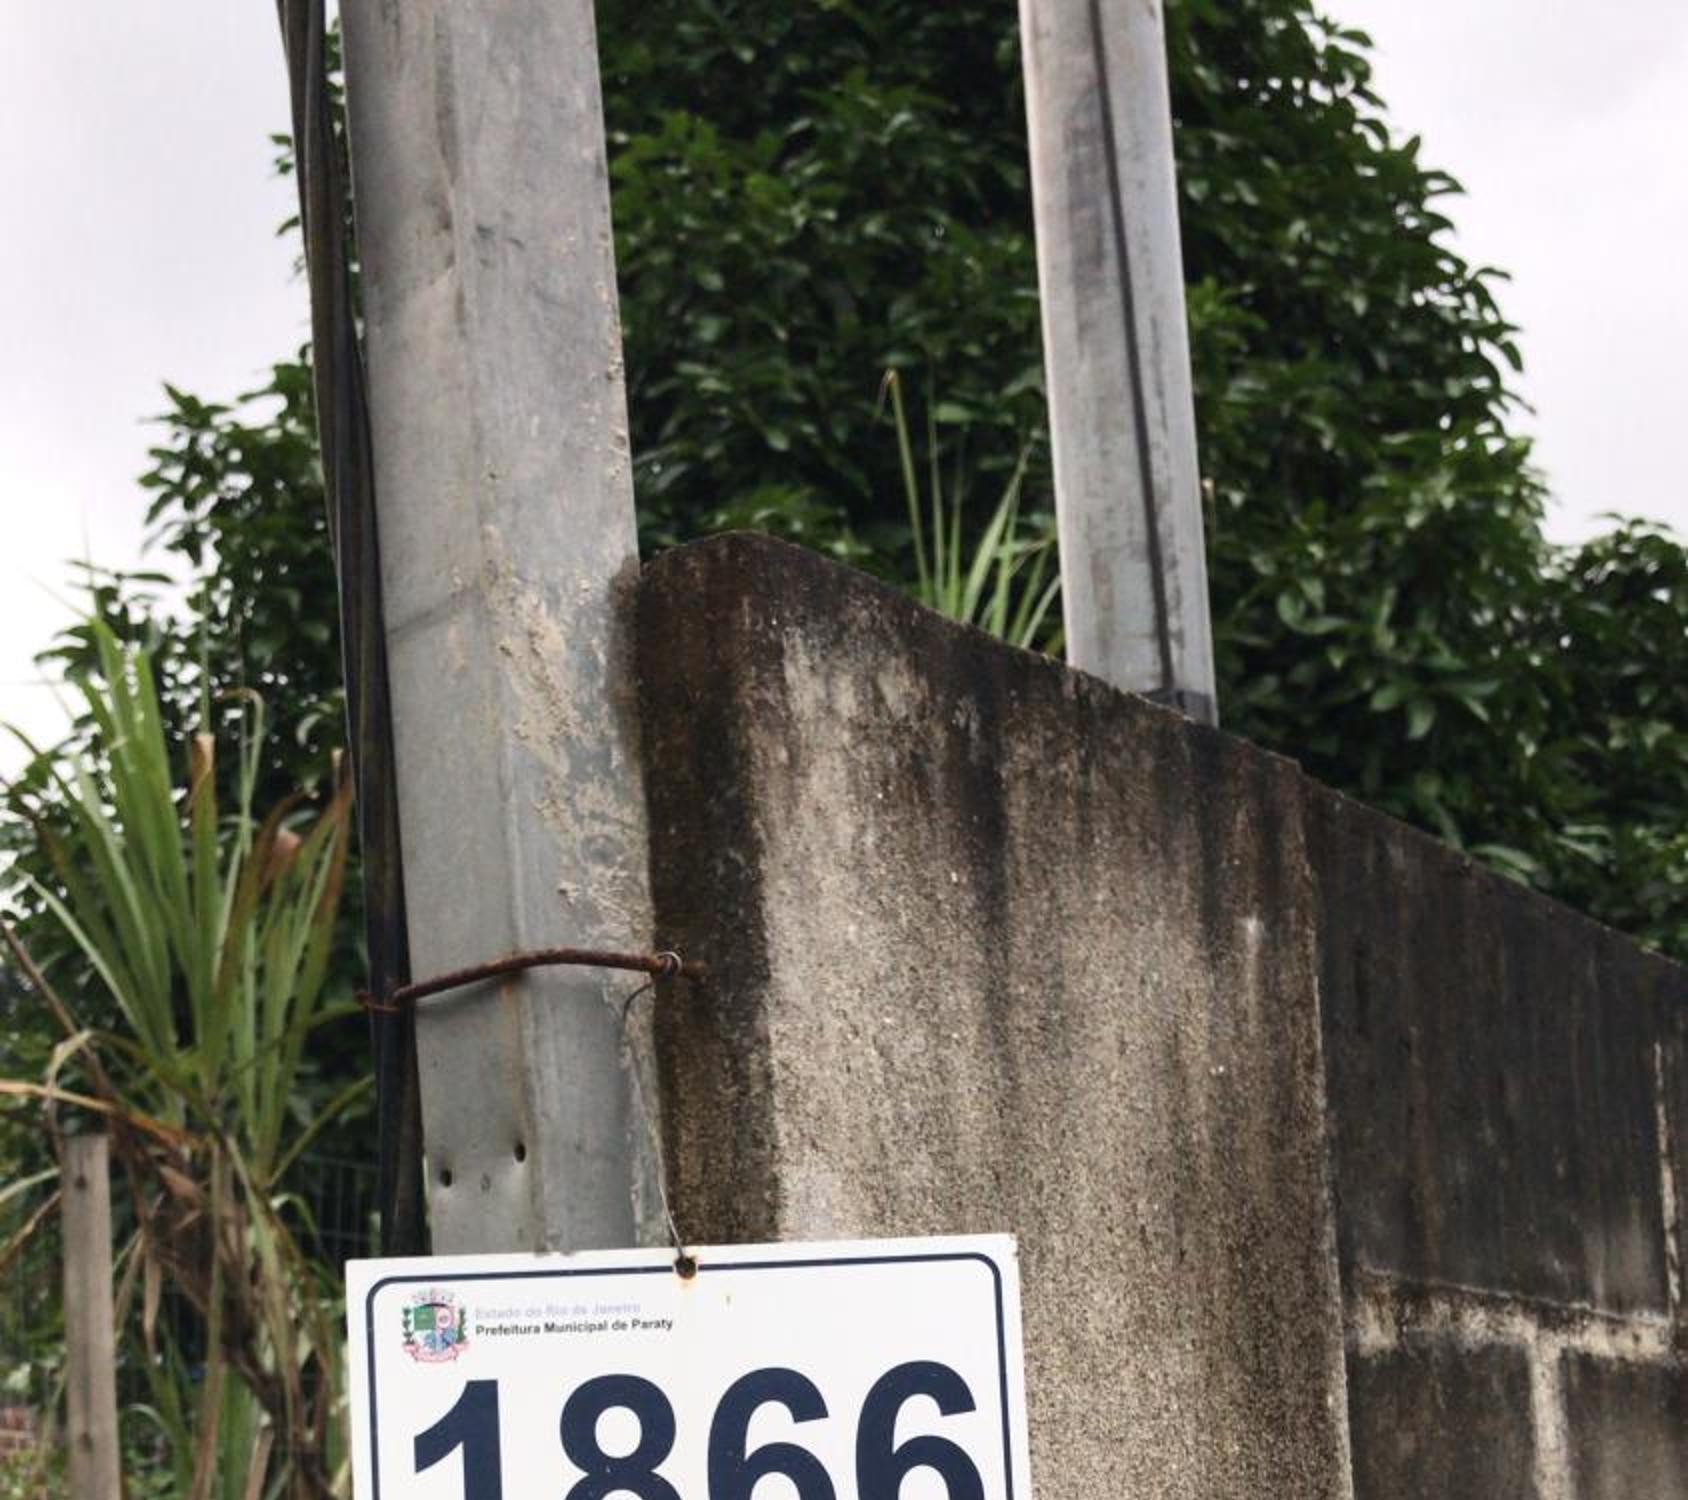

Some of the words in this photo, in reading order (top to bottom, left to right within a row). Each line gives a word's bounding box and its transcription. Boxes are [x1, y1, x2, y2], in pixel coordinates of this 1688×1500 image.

[475, 1306, 521, 1320] Estado
[545, 1304, 568, 1317] Rio
[592, 1302, 641, 1315] Janeiro
[475, 1323, 541, 1337] Prefeitura
[543, 1320, 608, 1335] Municipal
[611, 1319, 629, 1332] de
[631, 1317, 673, 1332] Paraty
